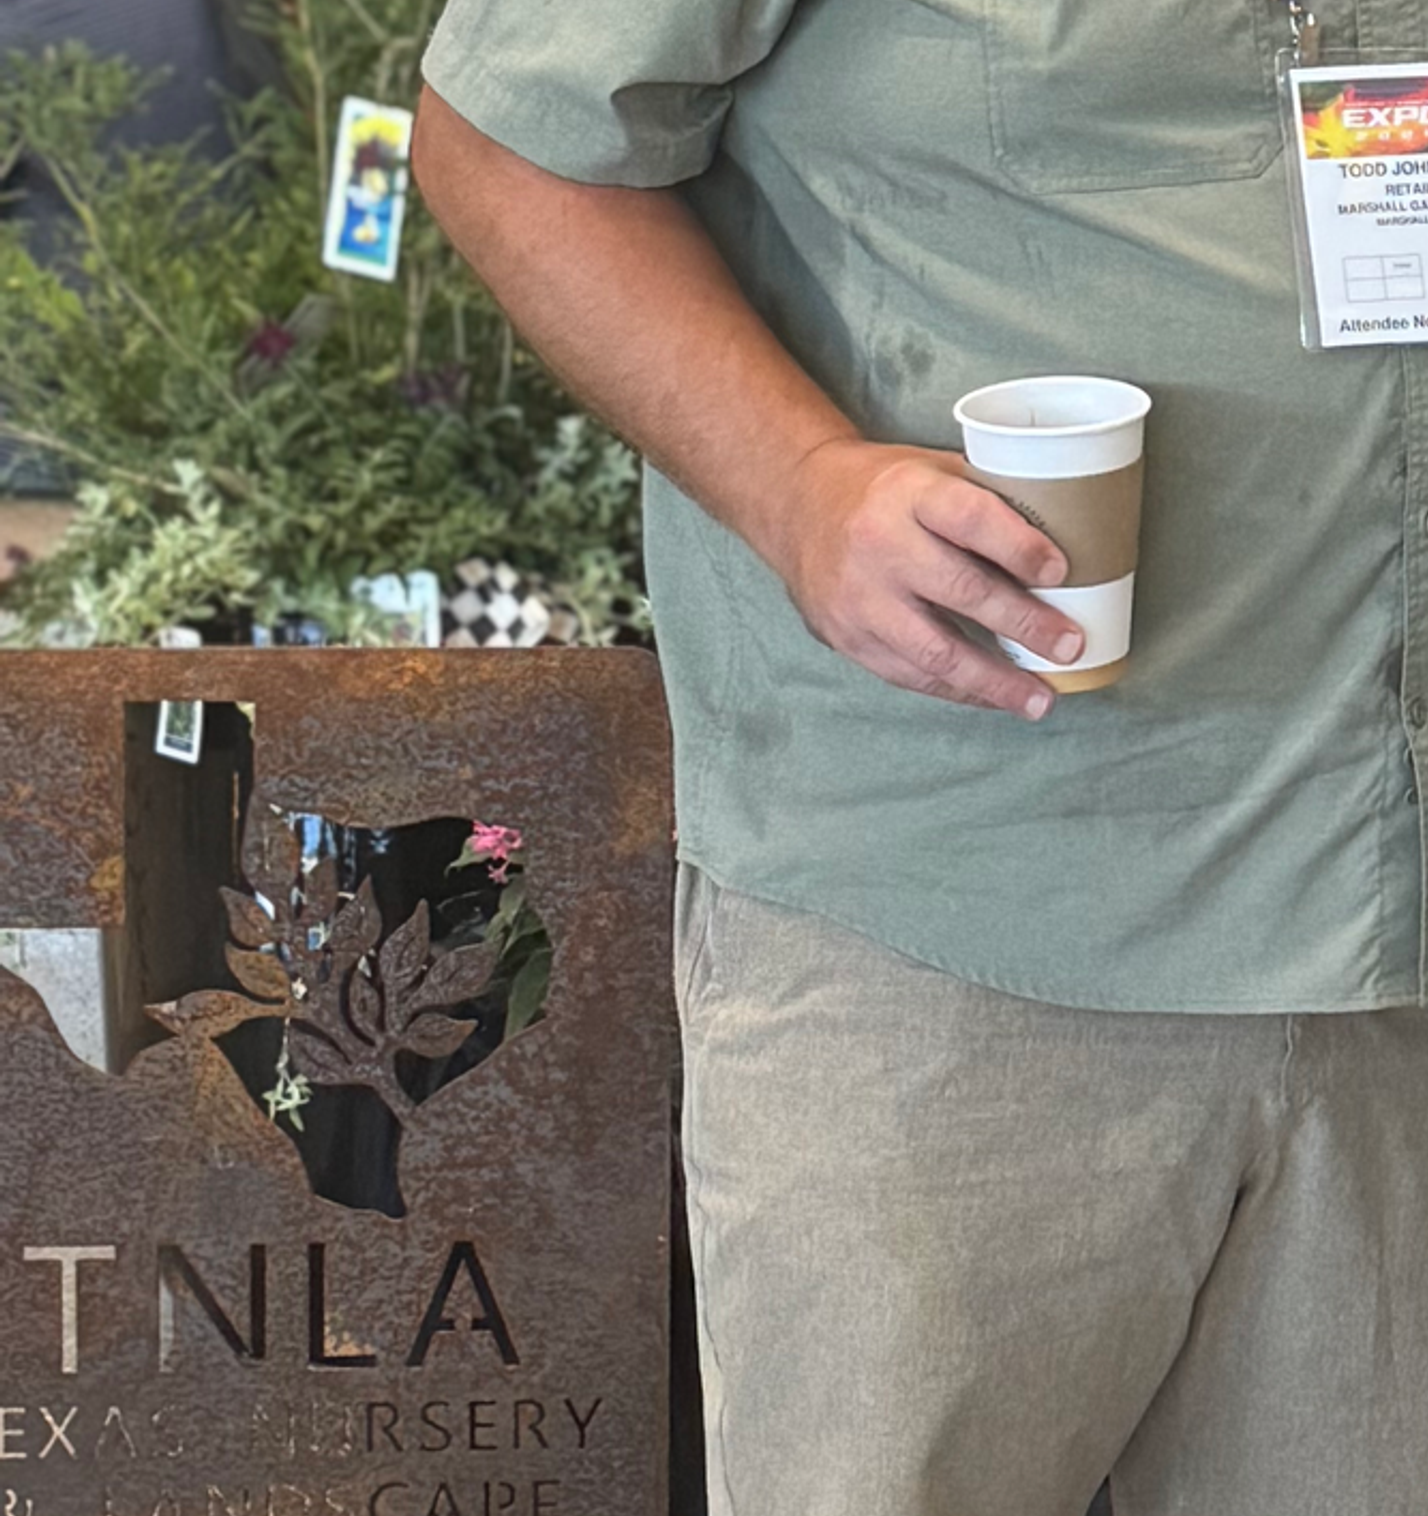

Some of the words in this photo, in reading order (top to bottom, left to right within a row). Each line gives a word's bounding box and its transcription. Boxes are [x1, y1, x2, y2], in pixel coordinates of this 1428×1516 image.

[1338, 162, 1387, 179] TODD
[1337, 200, 1407, 215] MARSHALL
[1339, 316, 1410, 333] Attendee
[23, 1240, 521, 1375] TNLA
[250, 1397, 602, 1459] NURSERY
